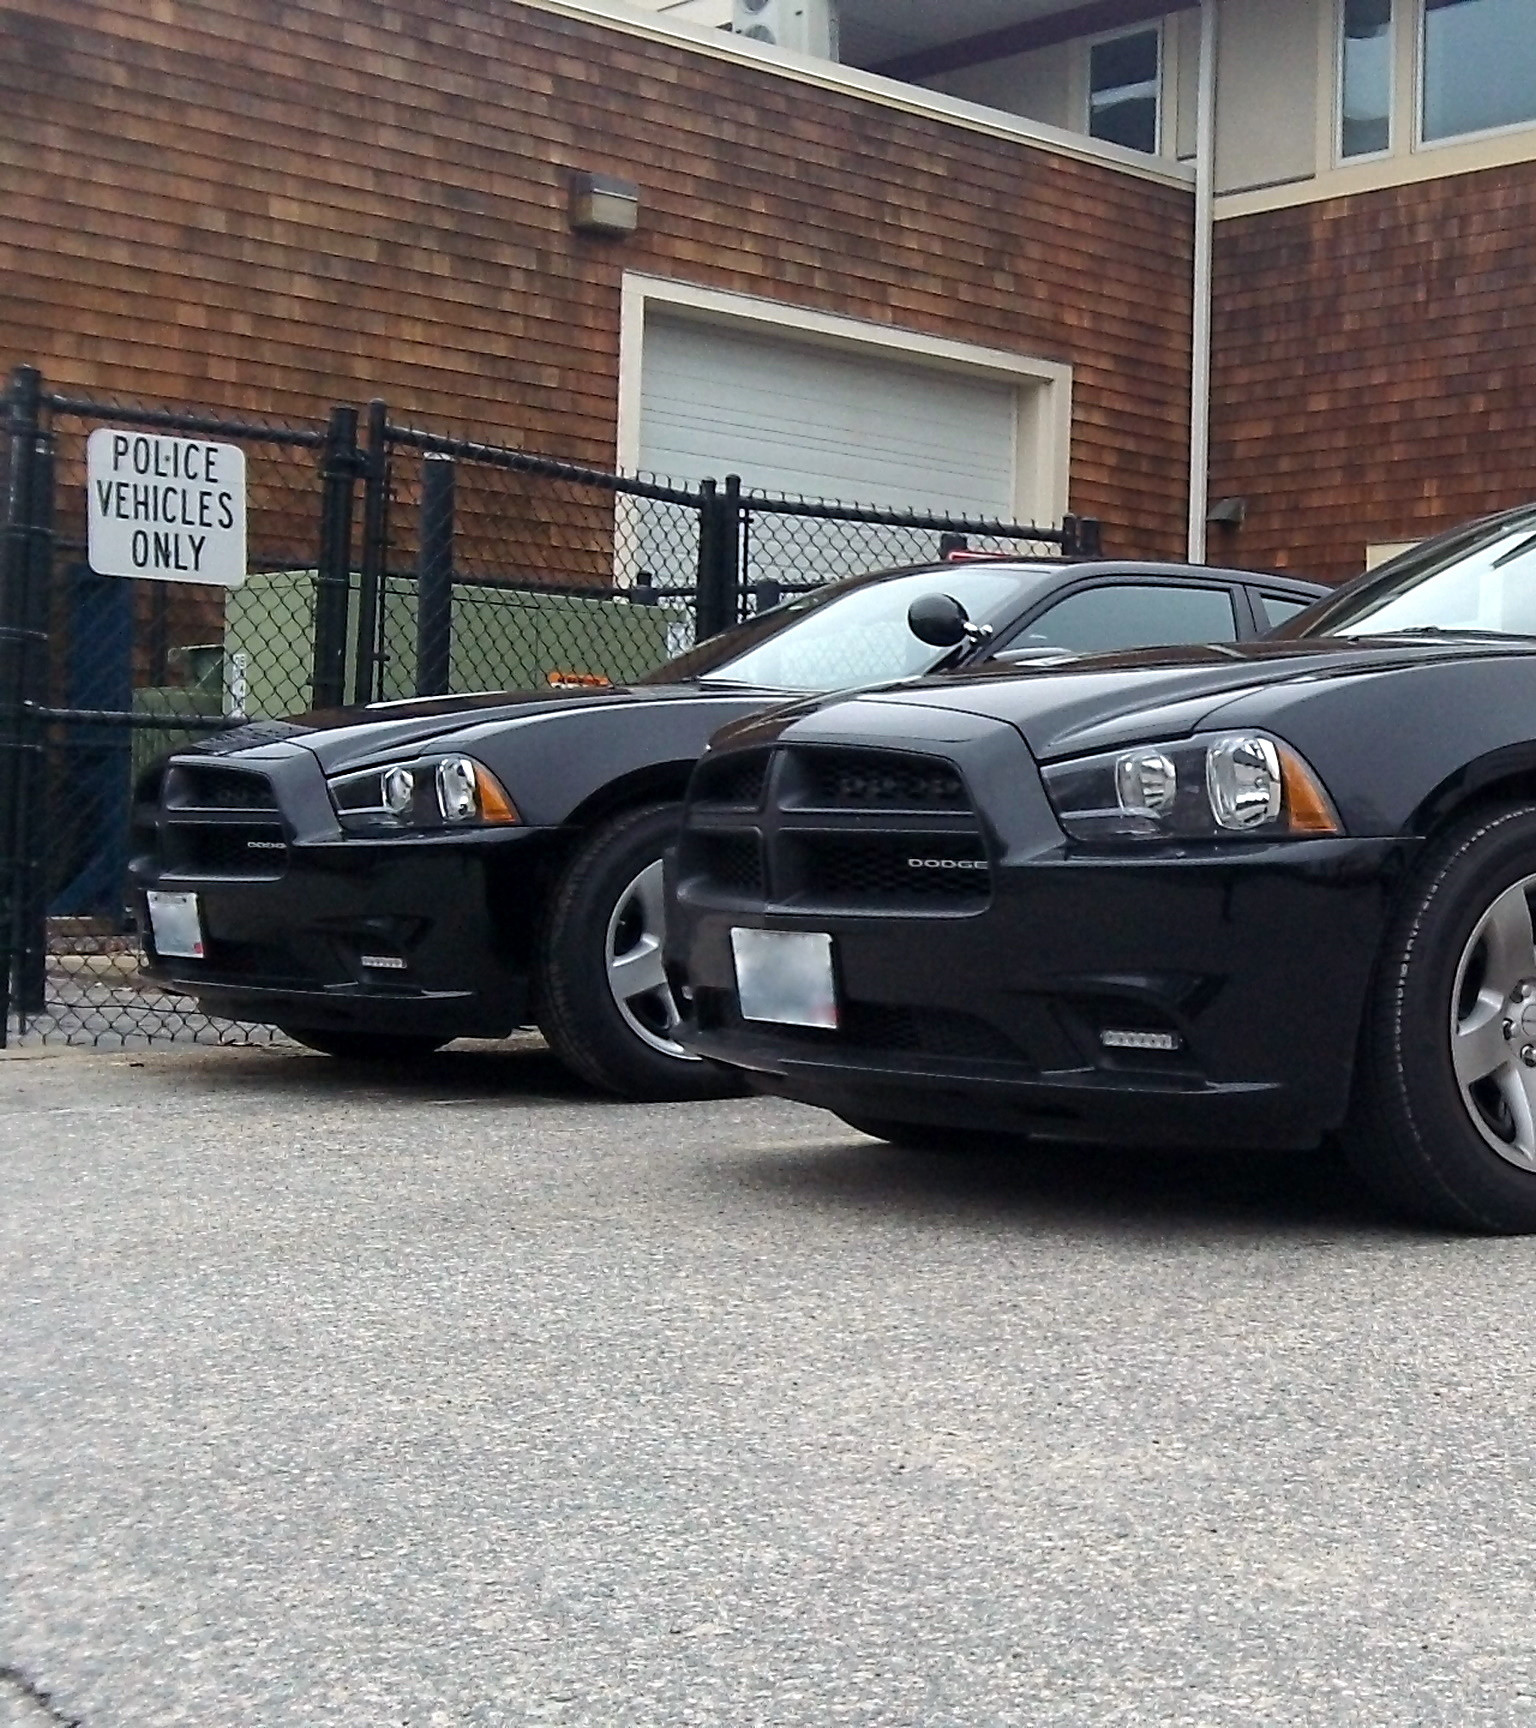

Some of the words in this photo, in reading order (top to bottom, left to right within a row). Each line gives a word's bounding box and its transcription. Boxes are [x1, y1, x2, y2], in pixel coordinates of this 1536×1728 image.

[113, 435, 218, 483] POLICE
[97, 479, 234, 529] VEHICLES
[132, 530, 206, 572] ONLY
[908, 858, 988, 870] DODGE
